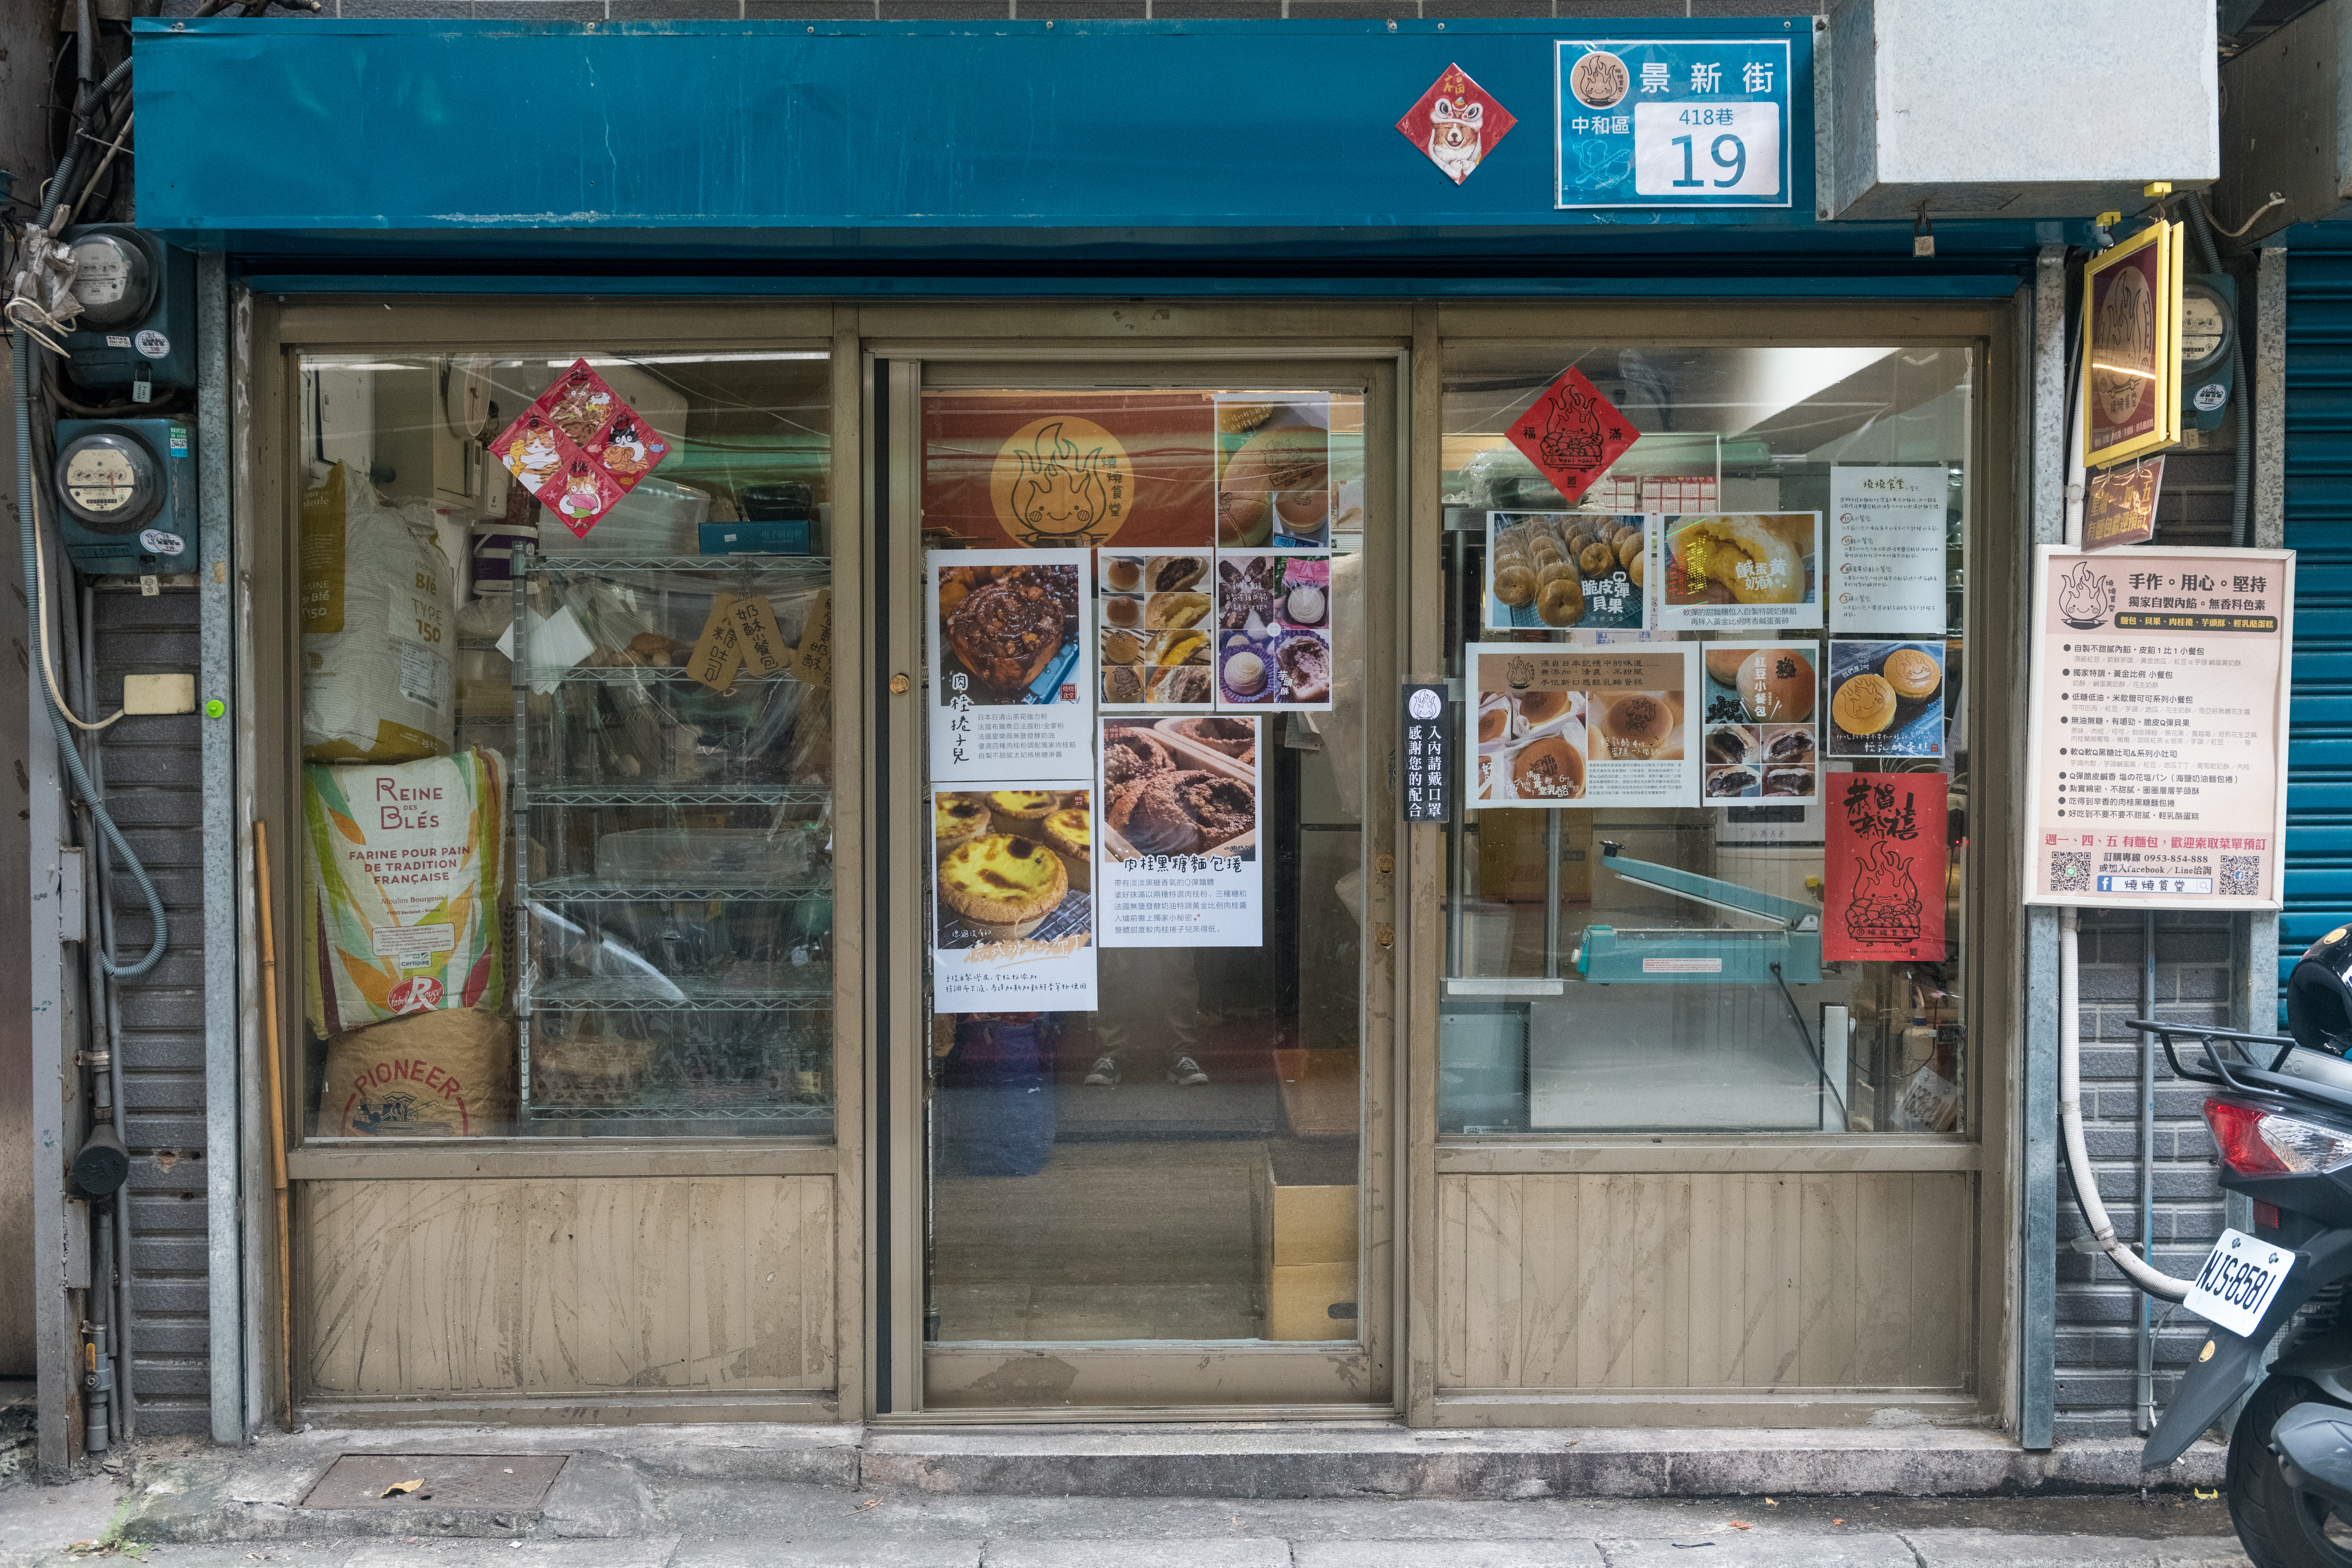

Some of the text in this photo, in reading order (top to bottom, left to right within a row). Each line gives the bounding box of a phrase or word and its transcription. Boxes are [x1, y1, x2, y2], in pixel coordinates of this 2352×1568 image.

[1444, 74, 1466, 94] 福
[1639, 62, 1773, 94] 景新街
[1679, 109, 1734, 126] 418巷
[1572, 116, 1630, 135] 中和區
[1671, 134, 1747, 188] 19
[570, 368, 588, 381] 旺
[528, 412, 540, 428] 吉
[1523, 427, 1535, 439] 福
[1609, 428, 1621, 440] 滿
[1102, 456, 1123, 517] 燒燒食堂
[1863, 479, 1904, 490] 燒燒食堂
[1735, 558, 1787, 579] 鹹蛋黃
[416, 572, 437, 596] Blé
[1745, 574, 1774, 591] 奶酥
[2128, 573, 2267, 593] 手作。用心。堅持
[311, 590, 330, 602] Blé
[2105, 579, 2117, 613] 燒燒食堂
[1593, 596, 1623, 614] 貝果
[2128, 596, 2266, 612] 獨家自製內餡。無香料色素
[411, 598, 443, 626] TYPE
[1683, 607, 1797, 616] 軟彈的甜麵糰包入自製特調奶酥餡
[1691, 617, 1789, 626] 再拌入黃金比例烤香鹹蛋黃碎
[2120, 616, 2274, 629] 麵包、貝果、肉桂捲、芋頭酥、輕乳酪蛋糕
[416, 619, 441, 643] 150
[1842, 664, 1869, 678] 我們是2吋
[2149, 670, 2173, 679] 小餐包
[1754, 656, 1767, 717] 紅豆小餐包
[2072, 693, 2193, 704] 低糖低油。米歇爾可可系列小餐包
[951, 675, 971, 764] 肉桂捲子兒
[2071, 716, 2190, 727] 無油無糖。有嚼勁。脆皮Q彈貝果
[1600, 736, 1630, 747] 輕乳酪
[978, 751, 1062, 759] 自製不甜膩太妃核桃糖淋醬
[1611, 748, 1629, 757] 蛋糕
[2070, 748, 2178, 759] 軟Q軟Q黑糖吐司&系列小吐司
[1408, 725, 1422, 817] 感謝您的配合
[1428, 726, 1442, 817] 入內請戴口罩
[2069, 772, 2116, 781] Q彈脆皮鹹香
[2069, 784, 2200, 796] 紮實綿密、不甜膩。圈圈層層芋頭酥
[2069, 797, 2175, 808] 吃得到辛香的肉桂黑糖麵包捲
[2068, 809, 2200, 821] 好吃到不要不要不甜膩。輕乳酪蛋糕
[2045, 833, 2118, 847] 週一、四、五
[349, 846, 470, 860] FARINE POUR PAIN
[2103, 852, 2208, 863] 訂購專線 0953-854-888
[365, 859, 457, 872] DE TRADITION
[1124, 855, 1242, 873] 肉桂黑糖麵包捲
[374, 872, 450, 885] FRANÇAISE
[1114, 878, 1214, 887] 帶有淡淡黑糖香氣的Q彈麵體
[2125, 880, 2185, 892] 燒燒食堂
[410, 895, 444, 904] Bourgeois
[1114, 890, 1247, 898] 塗好抹滿以兩種特選肉桂粉、三種糖和
[1114, 902, 1247, 910] 法國無鹽發酵奶油特調黃金比例肉桂醬
[1114, 926, 1220, 934] 整體甜度較肉桂捲子兒來得低。
[968, 934, 1081, 961] 德式冰心布丁
[354, 1059, 460, 1100] PIONEER
